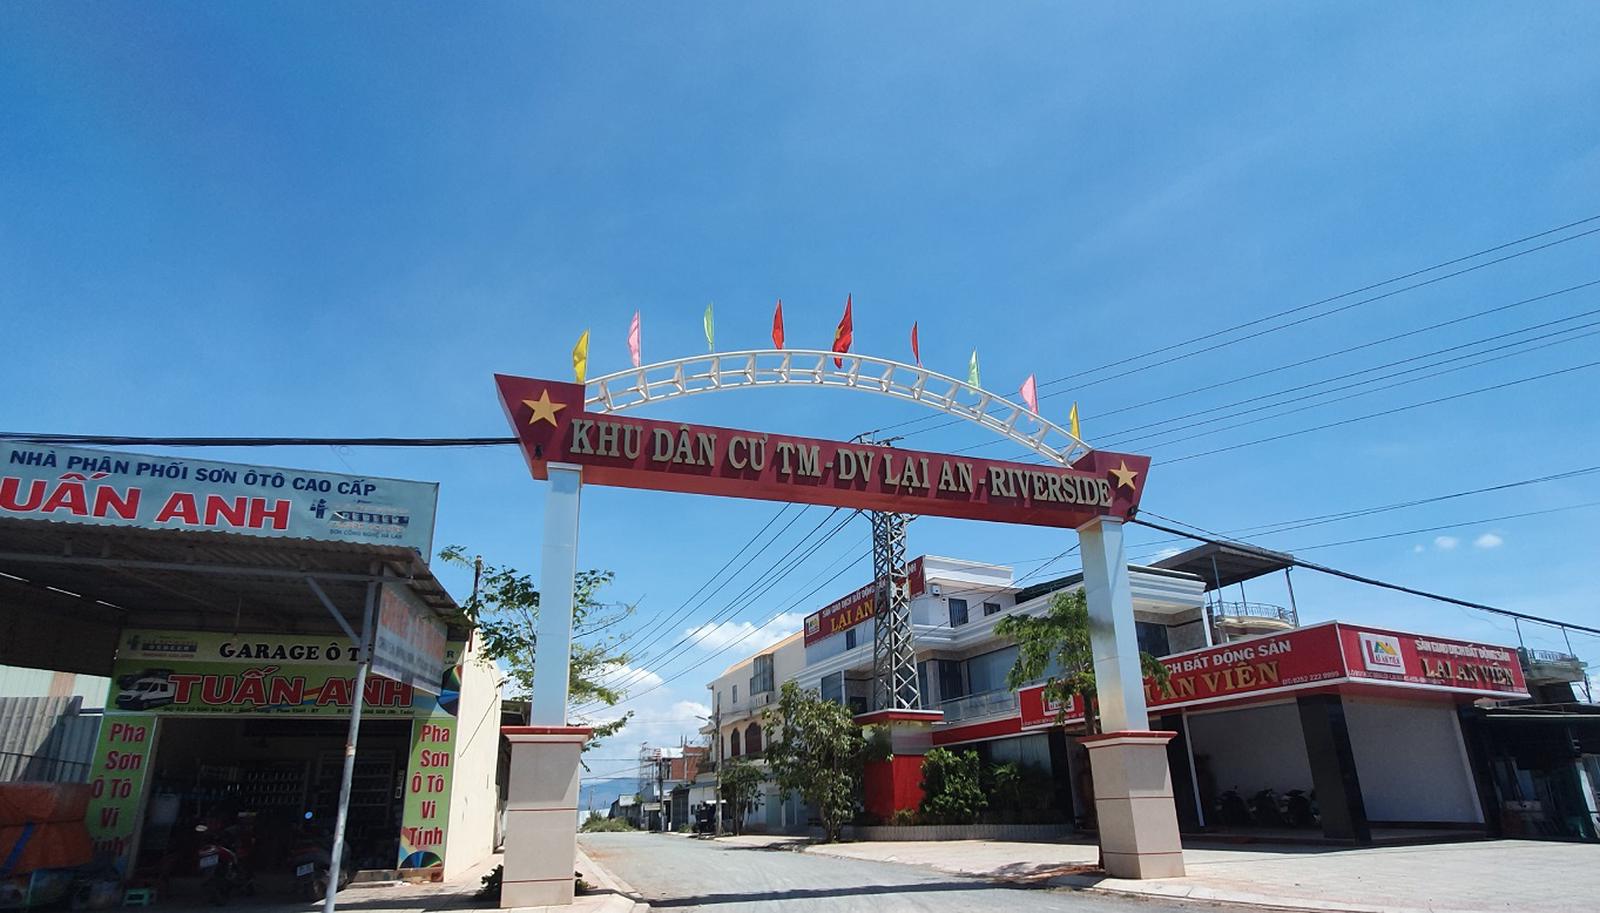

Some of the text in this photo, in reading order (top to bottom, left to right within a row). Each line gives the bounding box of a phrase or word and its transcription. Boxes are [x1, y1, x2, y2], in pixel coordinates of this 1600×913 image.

[570, 418, 643, 460] KHU
[652, 424, 717, 467] DÂN
[728, 433, 769, 471] CƯ
[883, 453, 931, 495] LẠI
[9, 450, 377, 497] NHÀ PHÂN PHỐI SƠN ÔTÔ CAO CẤP
[154, 492, 292, 532] ANH
[219, 642, 320, 660] GARAGE
[325, 642, 342, 662] Ô
[1183, 654, 1209, 673] BẤT
[1213, 647, 1255, 667] ĐỘNG
[1258, 639, 1292, 657] SẢN
[1202, 661, 1281, 694] VIÊN
[1479, 661, 1516, 686] VIÊN
[168, 665, 415, 707] TUẤN ANH
[108, 722, 147, 743] Pha
[420, 725, 451, 743] Pha
[105, 750, 143, 770] Sơn
[420, 749, 450, 768] Sơn
[91, 774, 132, 799] Ô Tô
[411, 771, 445, 793] Ô Tô
[101, 807, 120, 828] Vi
[421, 800, 437, 819] Vi
[408, 826, 443, 846] Tính
